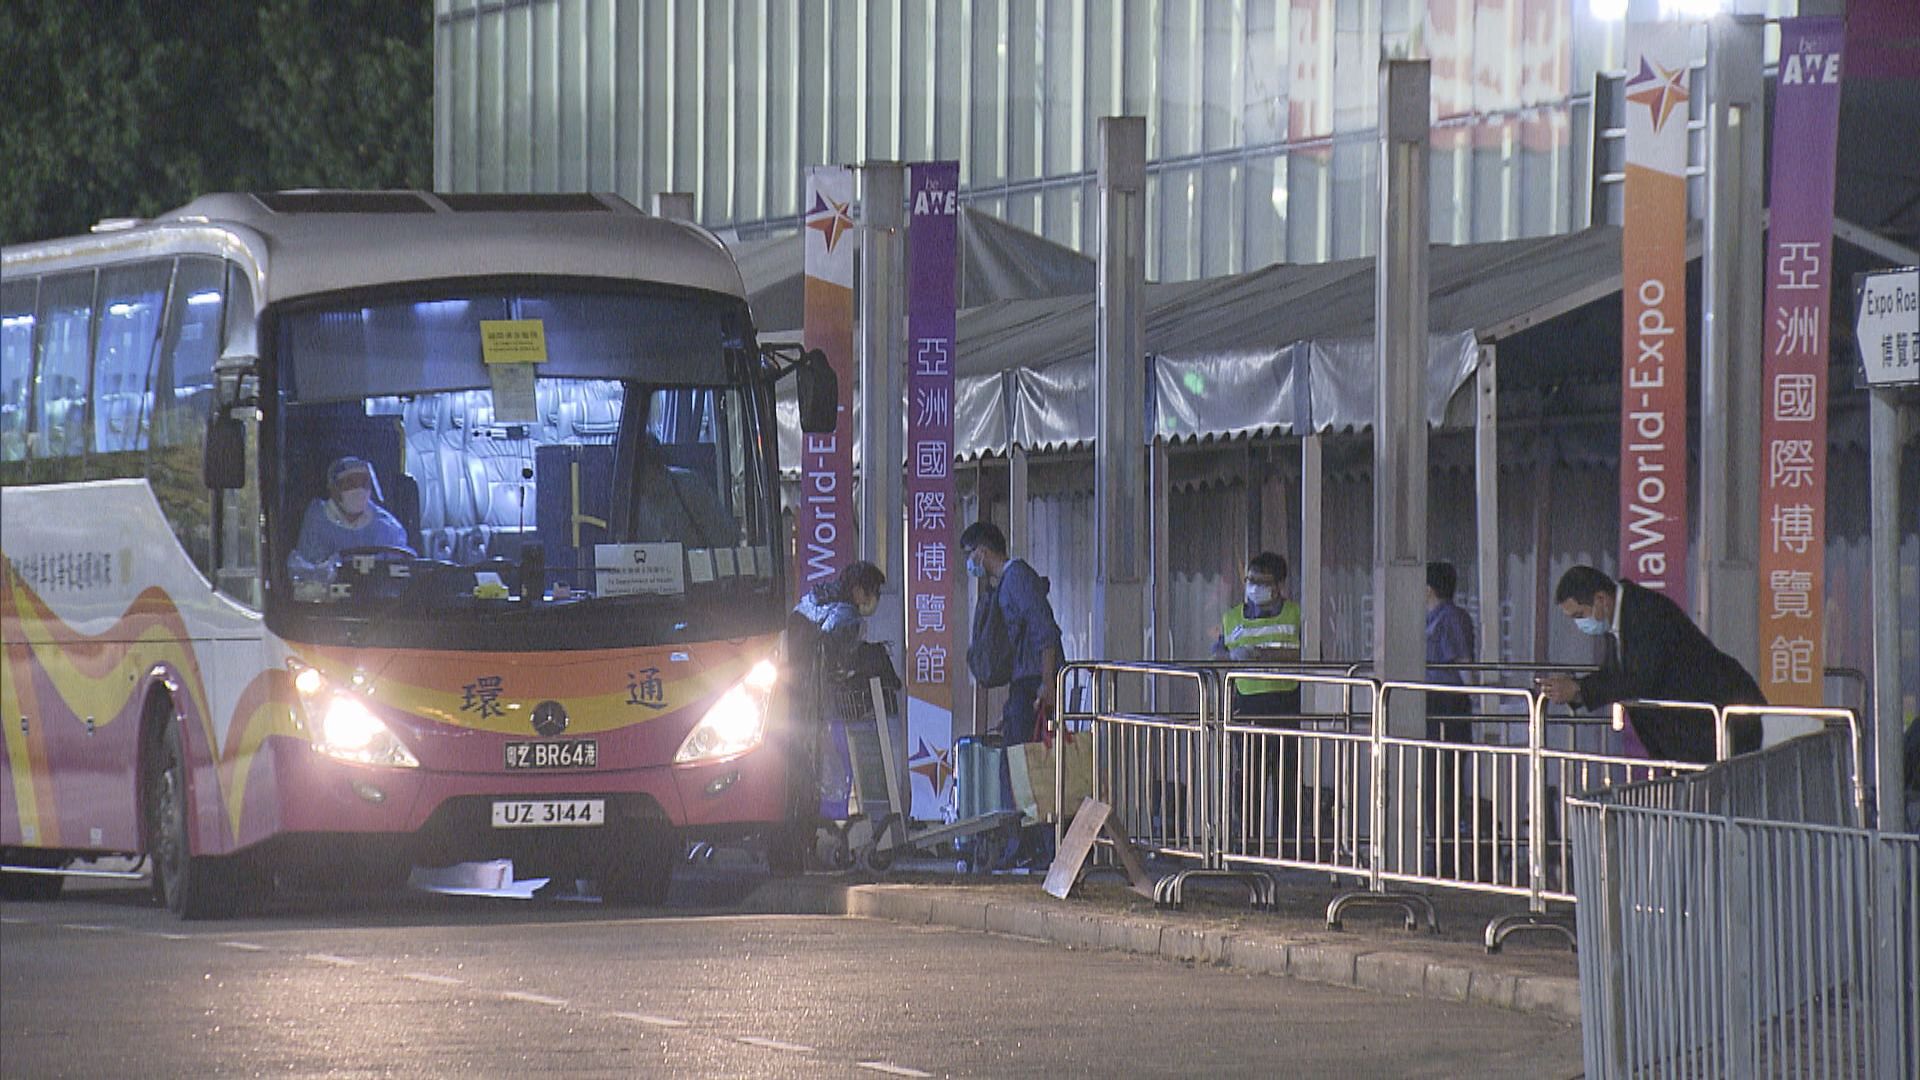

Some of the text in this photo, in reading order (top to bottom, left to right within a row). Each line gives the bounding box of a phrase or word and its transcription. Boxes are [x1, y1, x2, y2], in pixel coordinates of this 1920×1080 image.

[1783, 54, 1839, 85] AWE
[914, 190, 956, 215] AWE
[1867, 287, 1918, 318] Expo Roa
[1628, 278, 1675, 590] iaWorld-Expo
[1770, 242, 1820, 684] 亞洲國際博覽館
[914, 338, 948, 684] 亞洲國際博覽館
[460, 668, 667, 719] 環 通
[504, 803, 591, 823] UZ 3144
